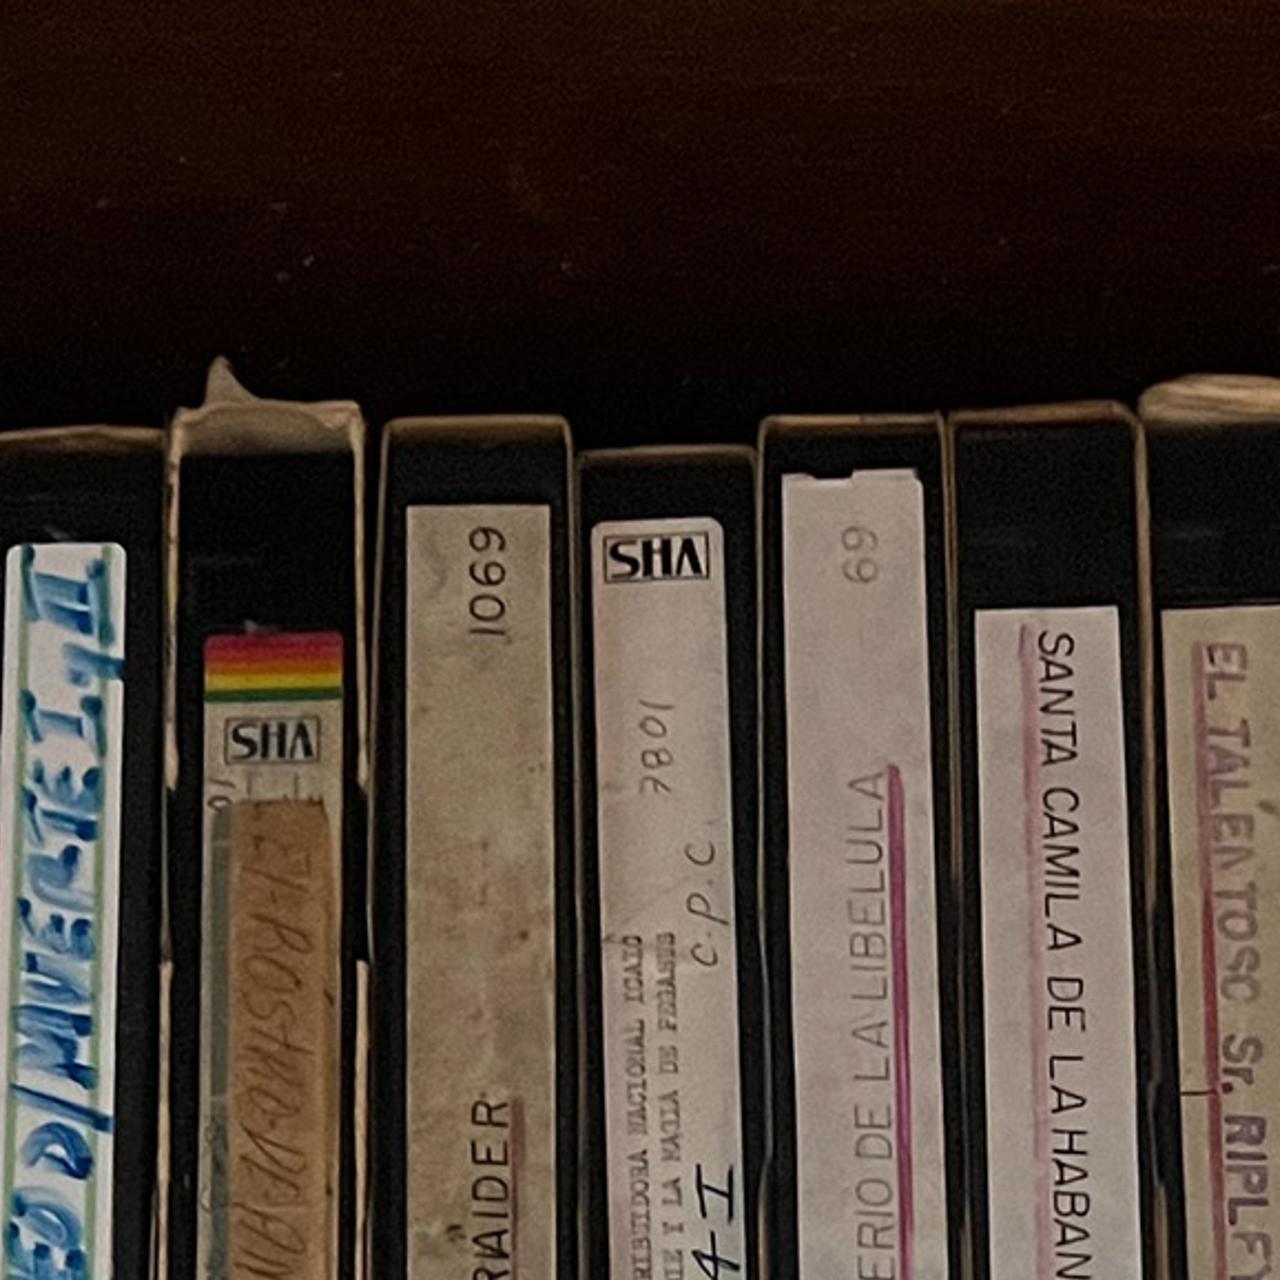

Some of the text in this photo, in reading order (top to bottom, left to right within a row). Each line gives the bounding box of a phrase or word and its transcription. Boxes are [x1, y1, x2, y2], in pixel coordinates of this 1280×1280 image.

[468, 525, 507, 637] 1069
[608, 538, 704, 580] VHS
[1037, 631, 1079, 768] SANTA
[1206, 640, 1249, 701] EL
[229, 721, 318, 761] VHS
[847, 771, 889, 1003] LIBELULA
[1042, 787, 1083, 952] CAMILA
[1047, 975, 1088, 1032] DE
[852, 1017, 892, 1080] LA
[1048, 1053, 1088, 1114] LA
[853, 1102, 894, 1162] DE
